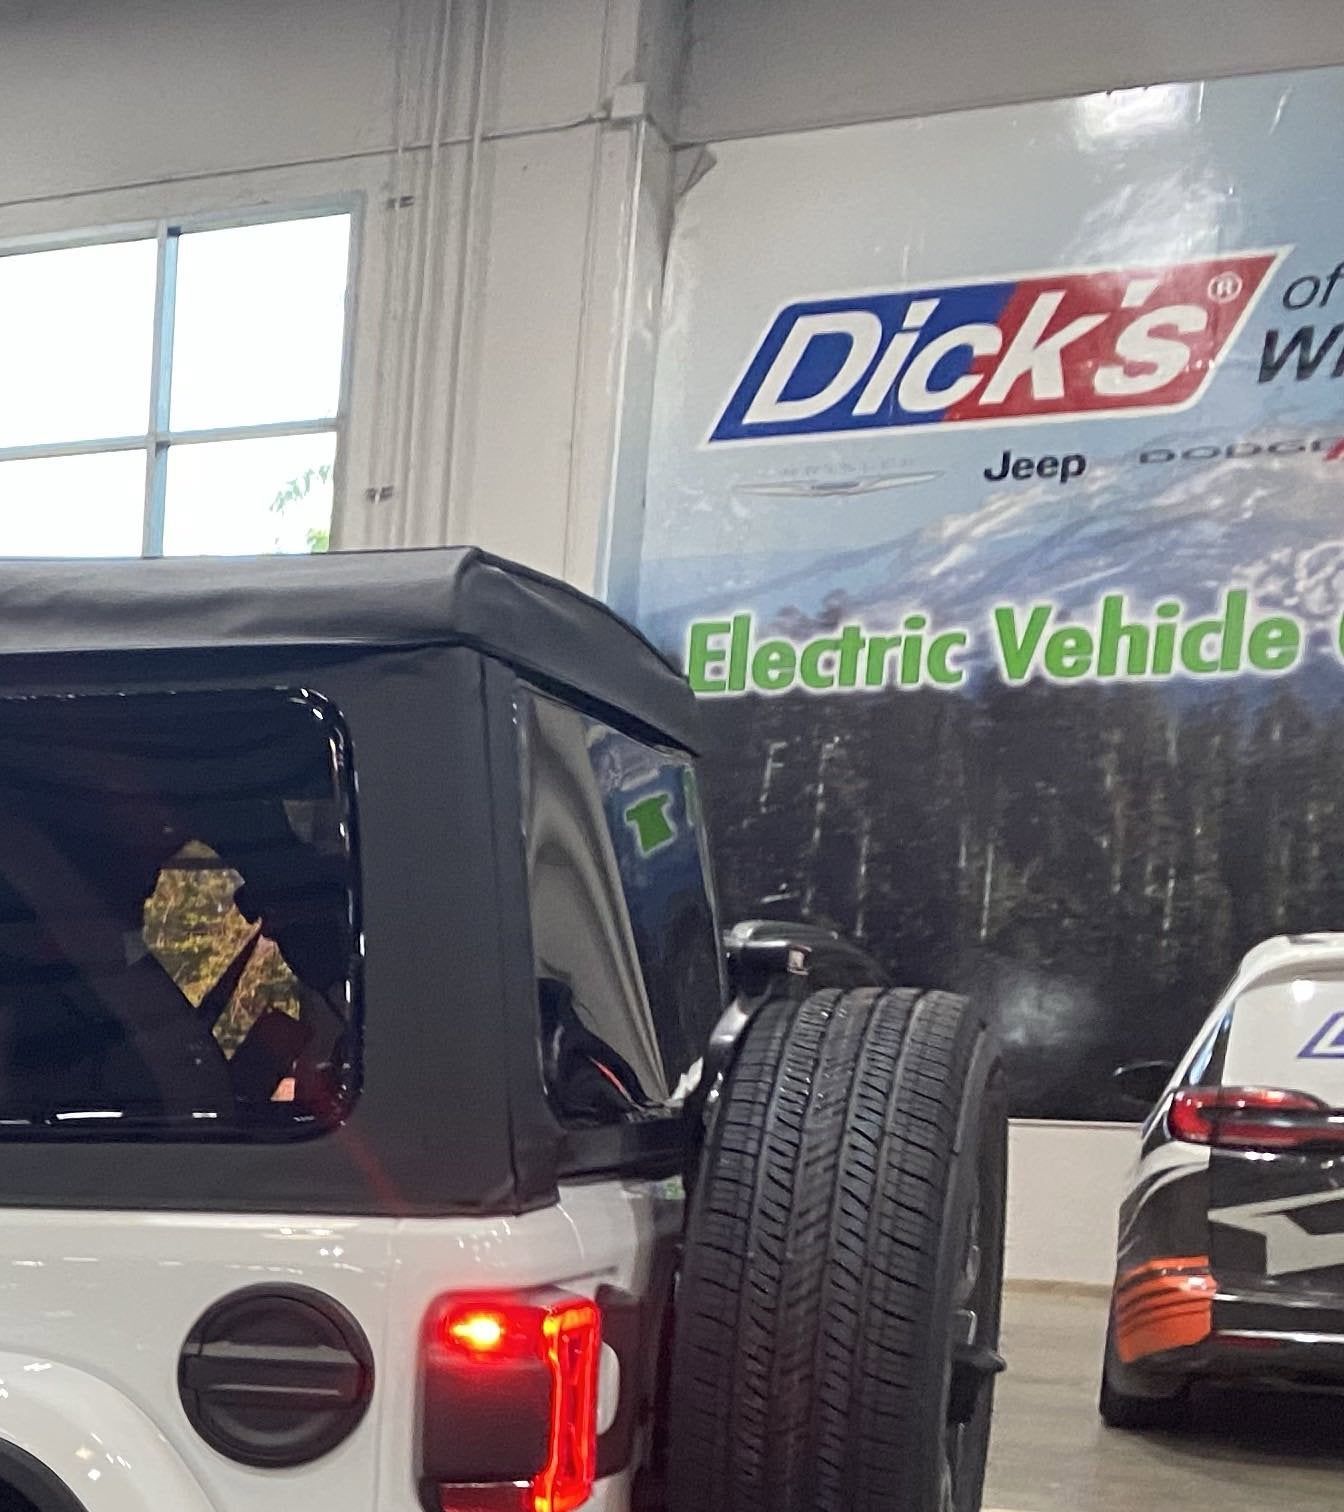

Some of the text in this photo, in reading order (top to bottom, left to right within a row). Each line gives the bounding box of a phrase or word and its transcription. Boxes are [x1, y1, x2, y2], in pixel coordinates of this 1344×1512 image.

[984, 451, 1086, 484] Jeep
[688, 614, 966, 693] Electric
[993, 590, 1300, 680] Vehicle
